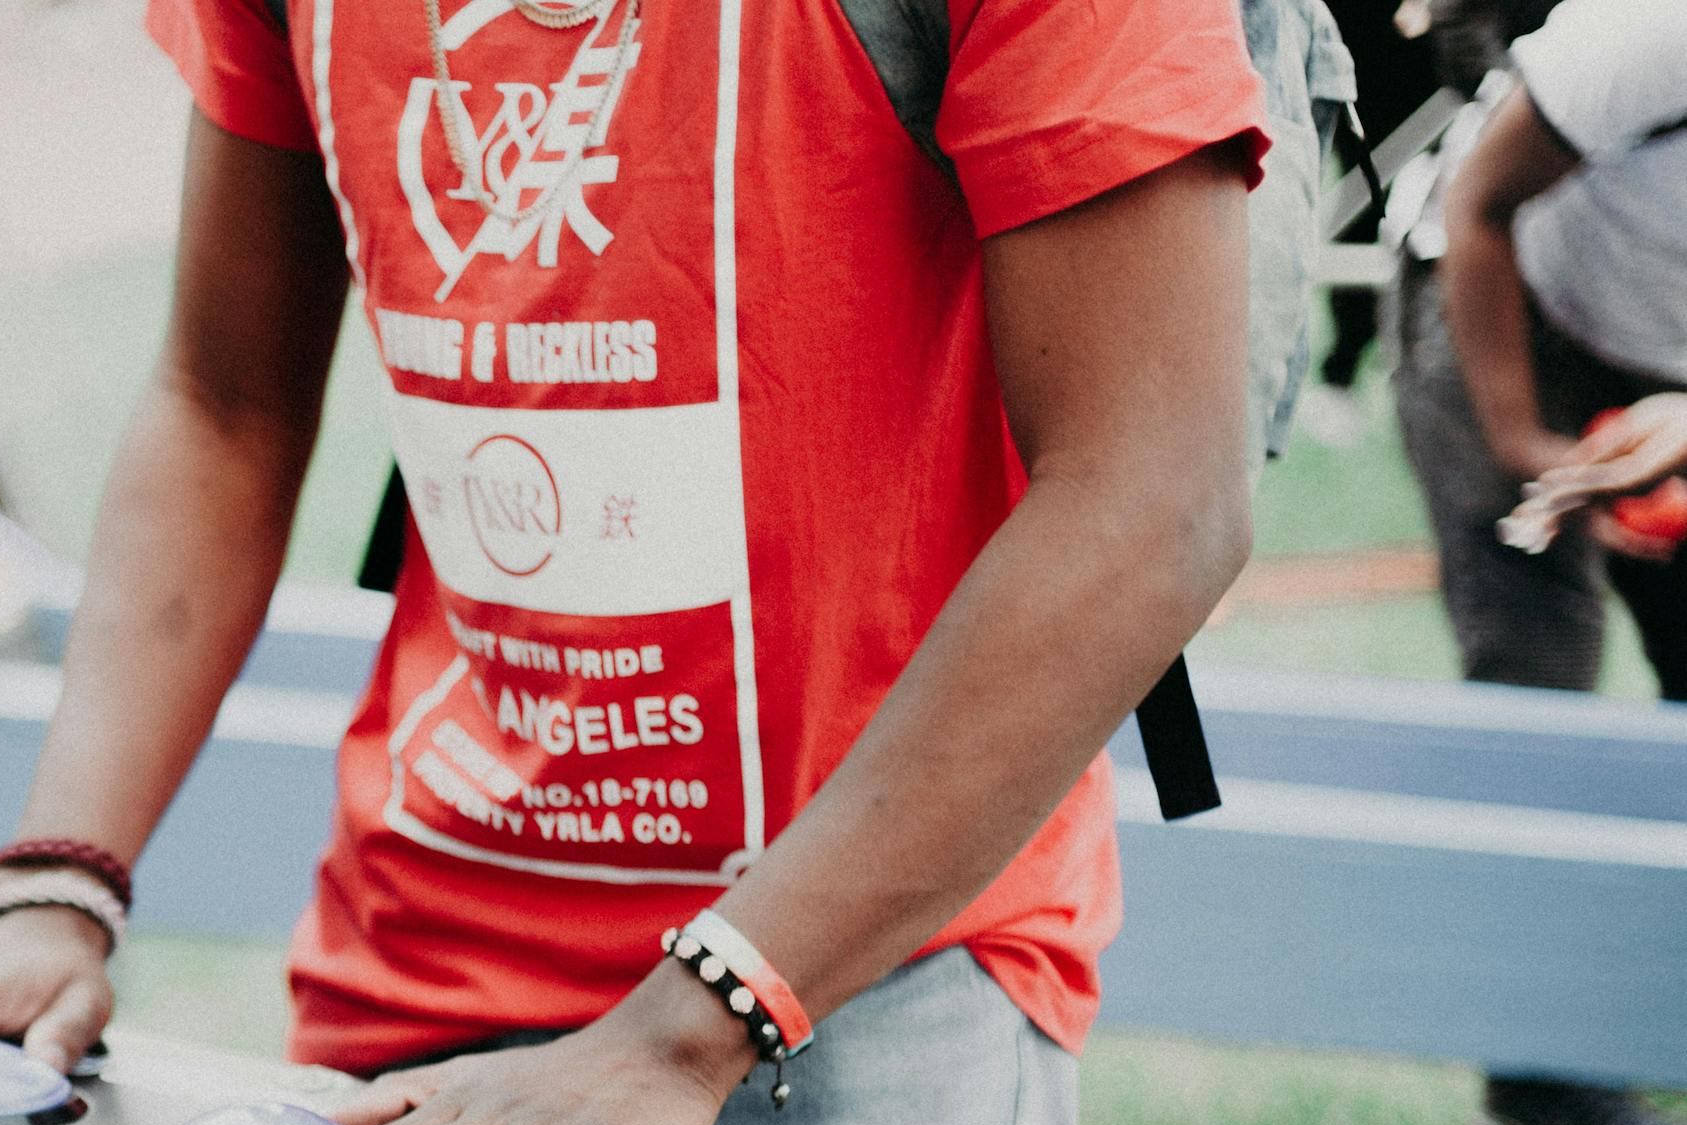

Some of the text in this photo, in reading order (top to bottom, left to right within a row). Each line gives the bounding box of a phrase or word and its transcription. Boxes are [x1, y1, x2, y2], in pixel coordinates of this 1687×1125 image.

[506, 319, 658, 384] RECKLESS
[499, 635, 561, 674] WITH
[564, 645, 664, 680] PRIDE
[497, 684, 705, 756] ANGELES
[534, 811, 693, 845] YRLA CO.
